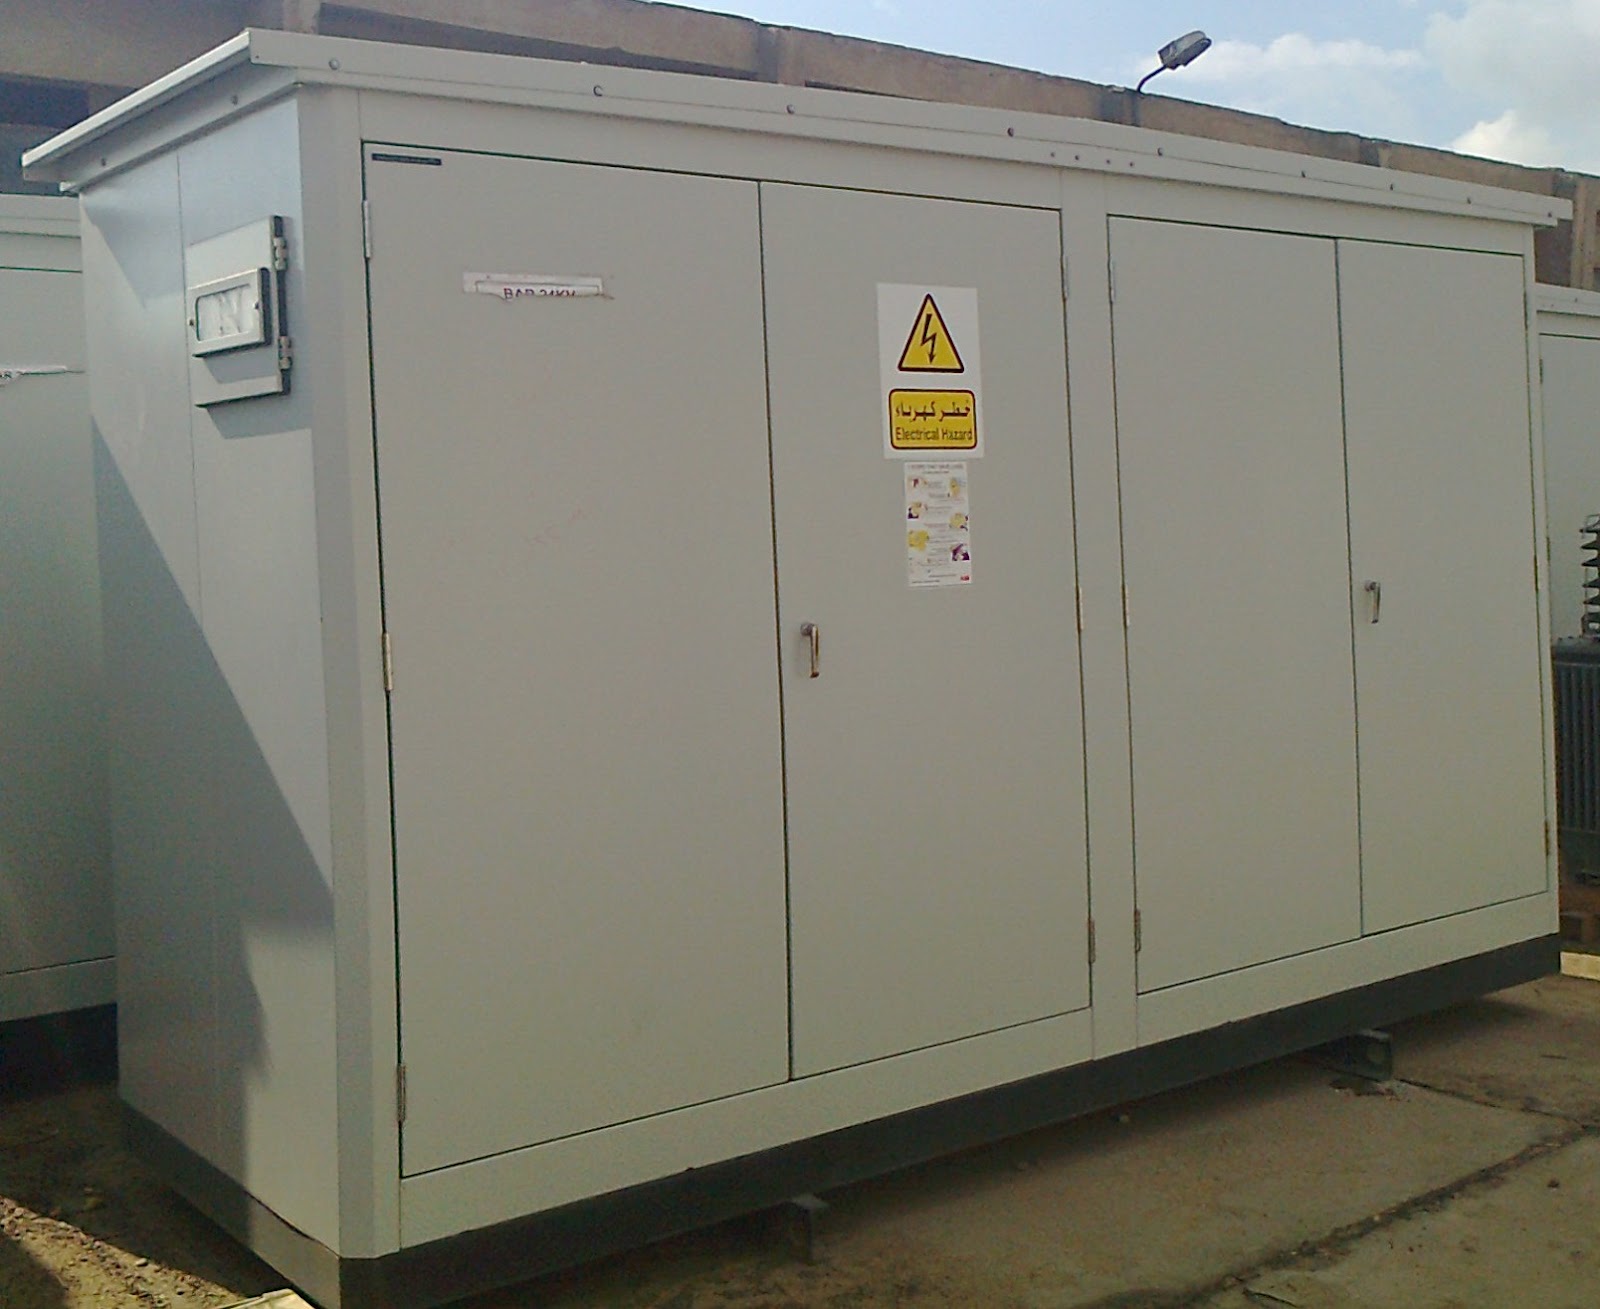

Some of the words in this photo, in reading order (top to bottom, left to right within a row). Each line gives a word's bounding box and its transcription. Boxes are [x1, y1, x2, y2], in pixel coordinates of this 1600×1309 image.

[895, 401, 936, 423] كهرباء
[939, 399, 971, 422] خطر
[895, 426, 939, 441] Electrical
[941, 427, 973, 441] Hazard
